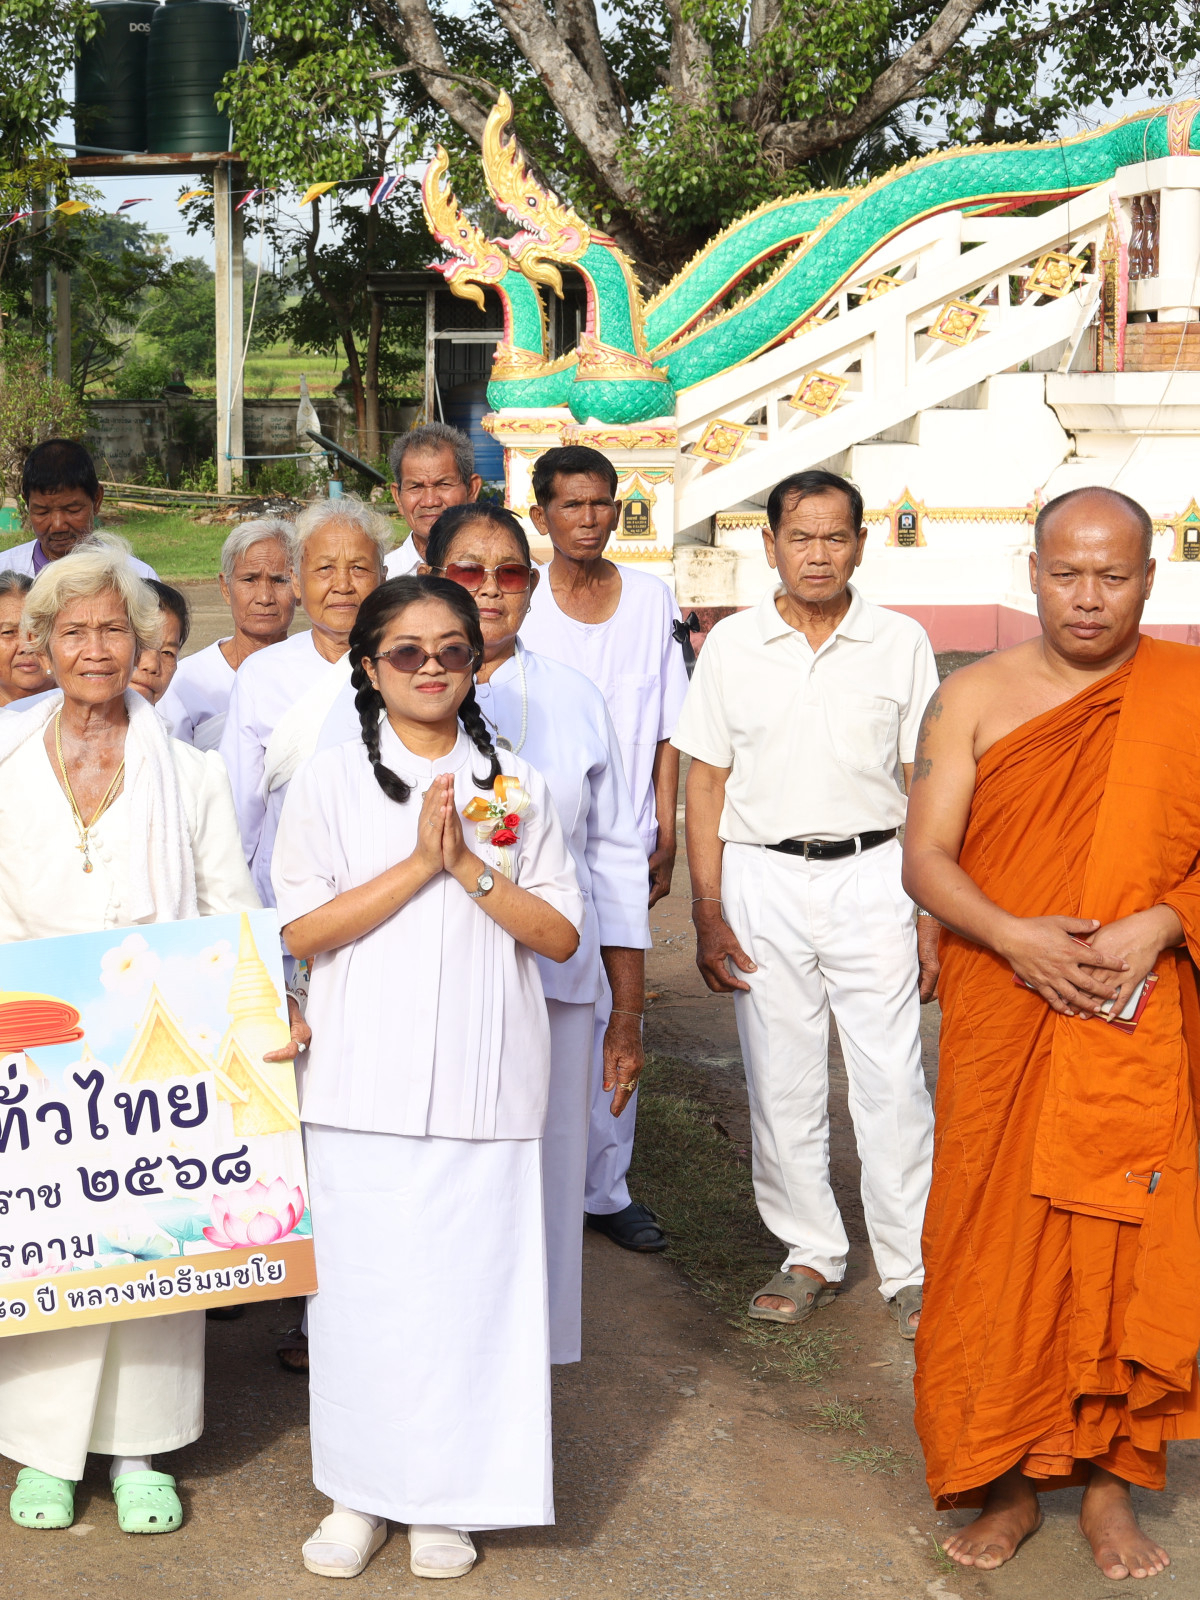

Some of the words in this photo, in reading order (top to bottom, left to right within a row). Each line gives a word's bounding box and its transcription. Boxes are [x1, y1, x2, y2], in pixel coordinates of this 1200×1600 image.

[129, 22, 151, 33] DOS
[77, 1144, 251, 1203] ๒๕๖๘
[37, 1286, 56, 1312] ปี
[67, 1257, 284, 1309] หลวงพ่อธัมมชโย
